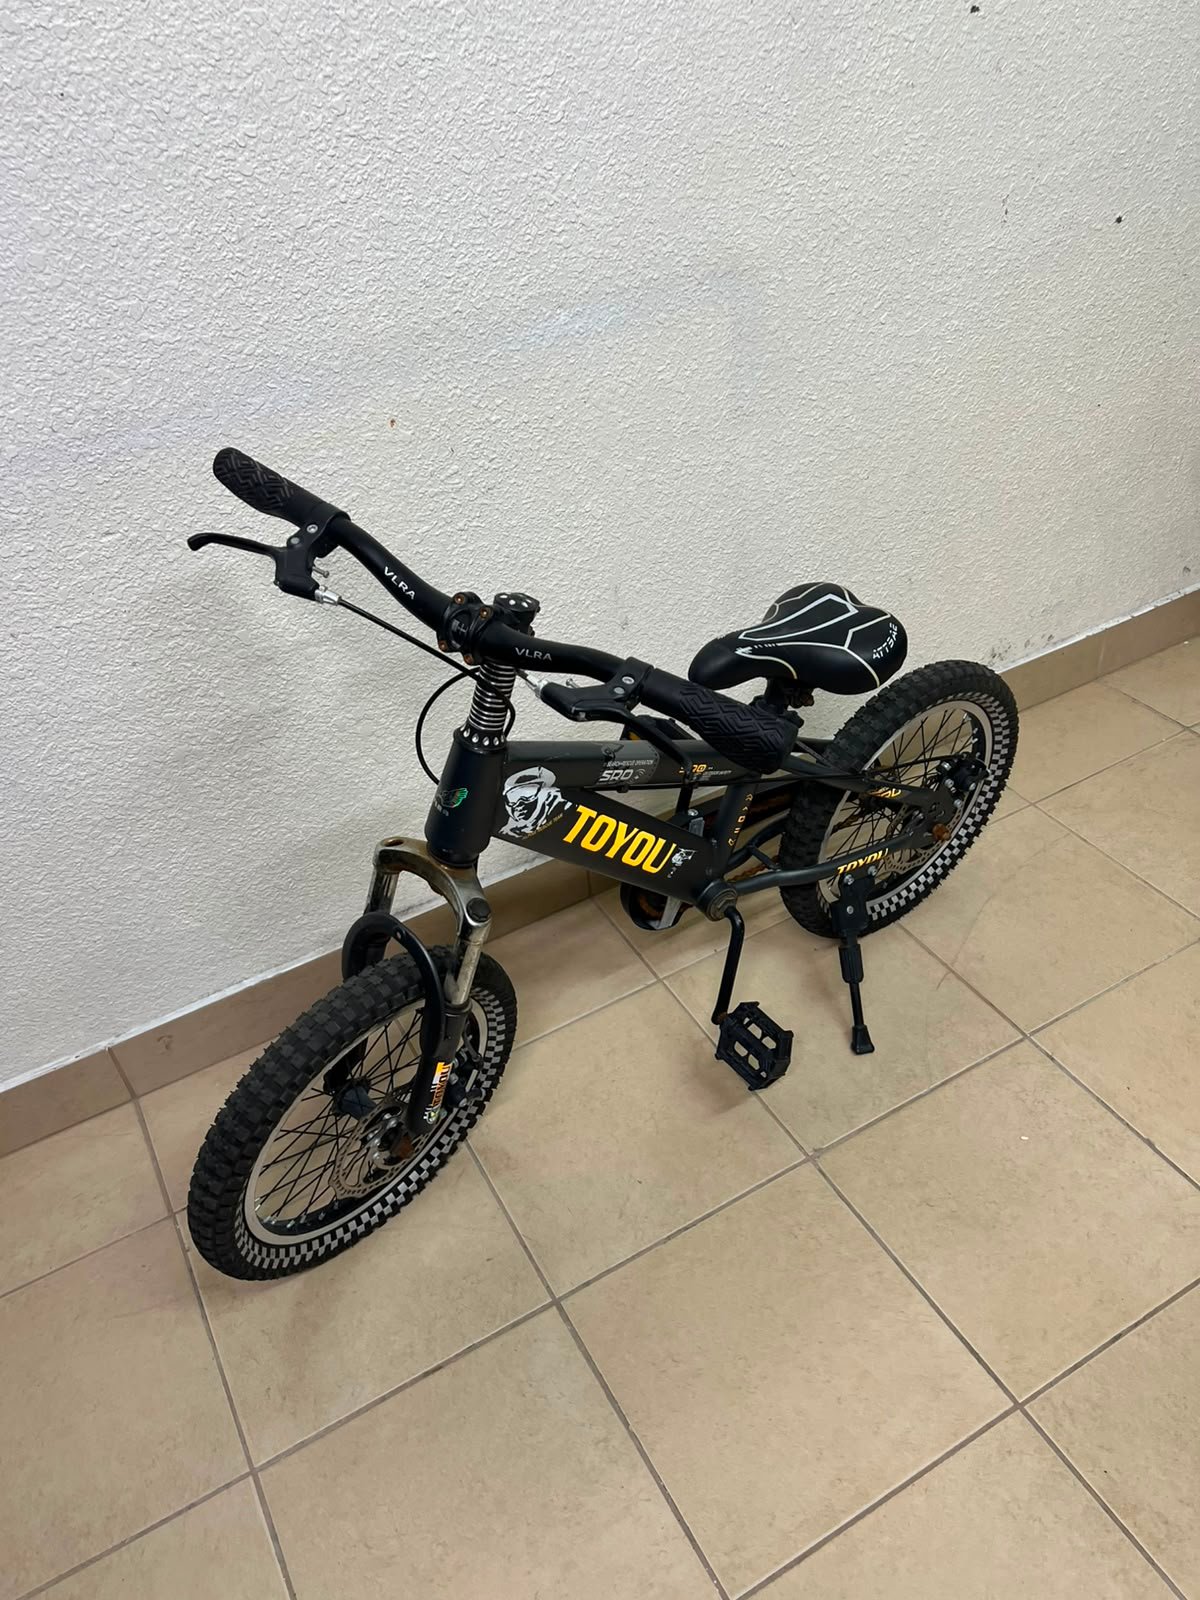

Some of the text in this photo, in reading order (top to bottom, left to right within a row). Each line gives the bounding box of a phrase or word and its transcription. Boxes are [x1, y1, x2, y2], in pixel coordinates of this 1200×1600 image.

[383, 566, 416, 600] VLRA
[515, 647, 552, 661] VLRA
[599, 769, 634, 781] SRO
[563, 804, 678, 874] TOYOU
